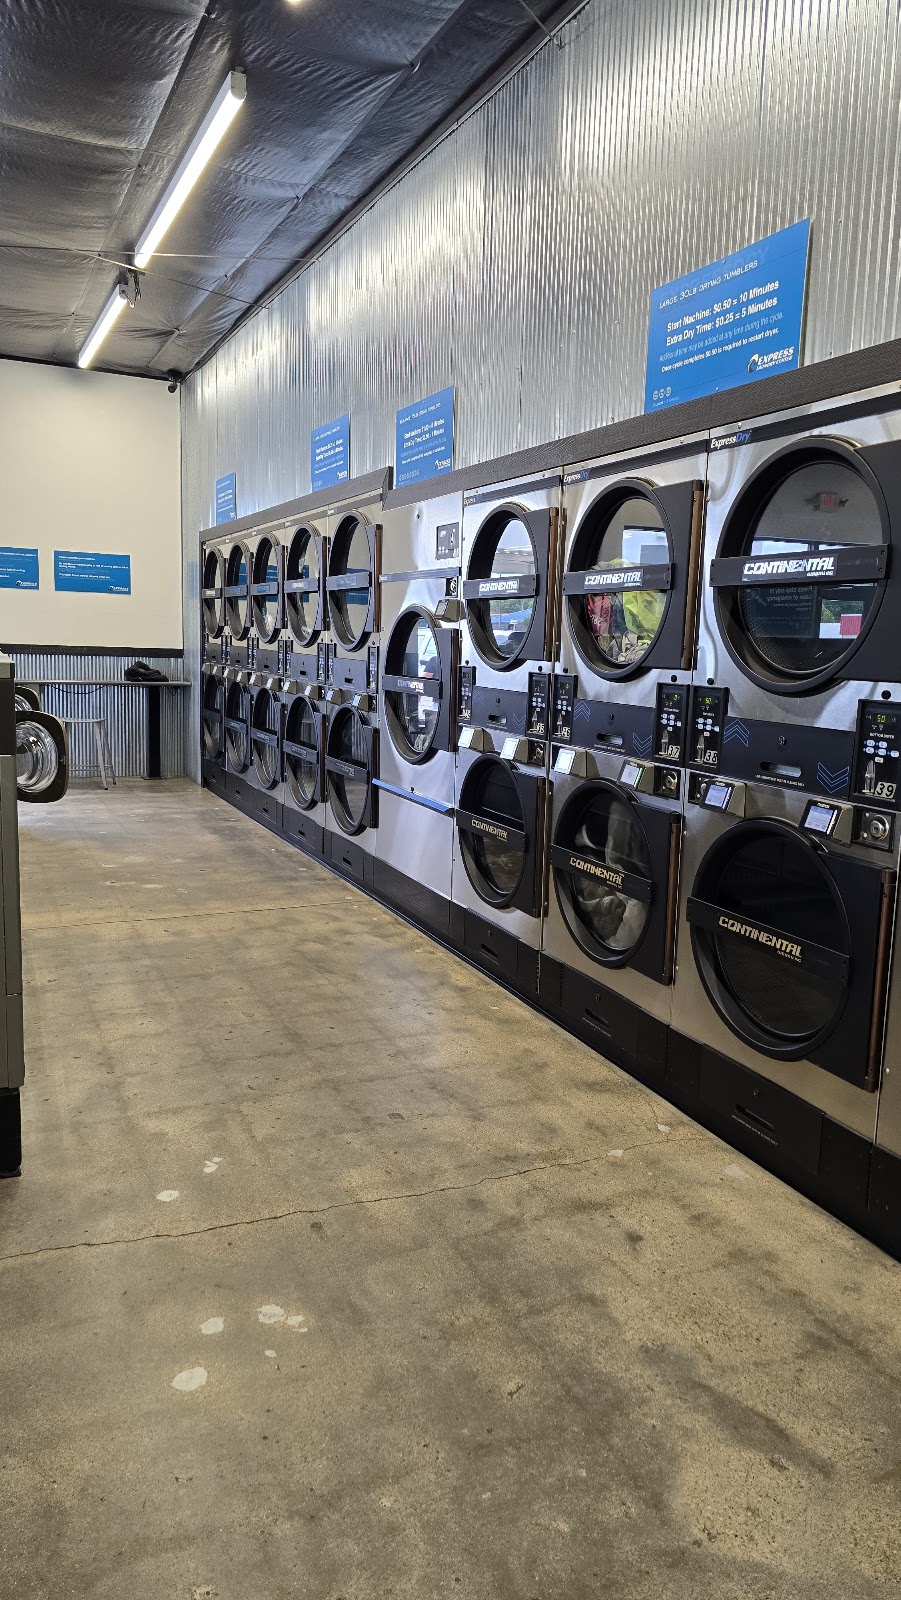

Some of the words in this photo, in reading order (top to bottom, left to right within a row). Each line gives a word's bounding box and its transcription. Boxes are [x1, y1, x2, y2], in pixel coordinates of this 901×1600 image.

[660, 296, 678, 309] LARGE
[680, 287, 697, 300] 30LB
[699, 276, 722, 292] DRYING
[724, 260, 758, 282] TUMBLERS
[667, 318, 682, 332] Start
[683, 308, 712, 326] Machine:
[713, 298, 732, 314] $0.50
[740, 292, 748, 303] 10
[749, 280, 779, 300] Minutes
[666, 333, 682, 346] Extra
[684, 329, 695, 339] Dry
[696, 321, 714, 334] Time:
[716, 312, 734, 328] $0.25
[741, 307, 747, 317] 5
[748, 297, 778, 315] Minutes
[704, 334, 719, 346] added
[744, 321, 760, 332] during
[760, 317, 768, 326] the
[723, 339, 742, 351] required
[758, 346, 794, 365] EXPRESS
[743, 557, 834, 574] CONTINENTAL
[585, 572, 642, 584] CONTINENTAL
[877, 714, 886, 722] 50
[668, 746, 679, 757] 37
[706, 751, 718, 762] 38
[876, 783, 894, 798] 39
[471, 818, 508, 839] CONTINENTAL
[570, 857, 624, 885] CONTINENTAL
[719, 915, 802, 957] CONTINENTAL
